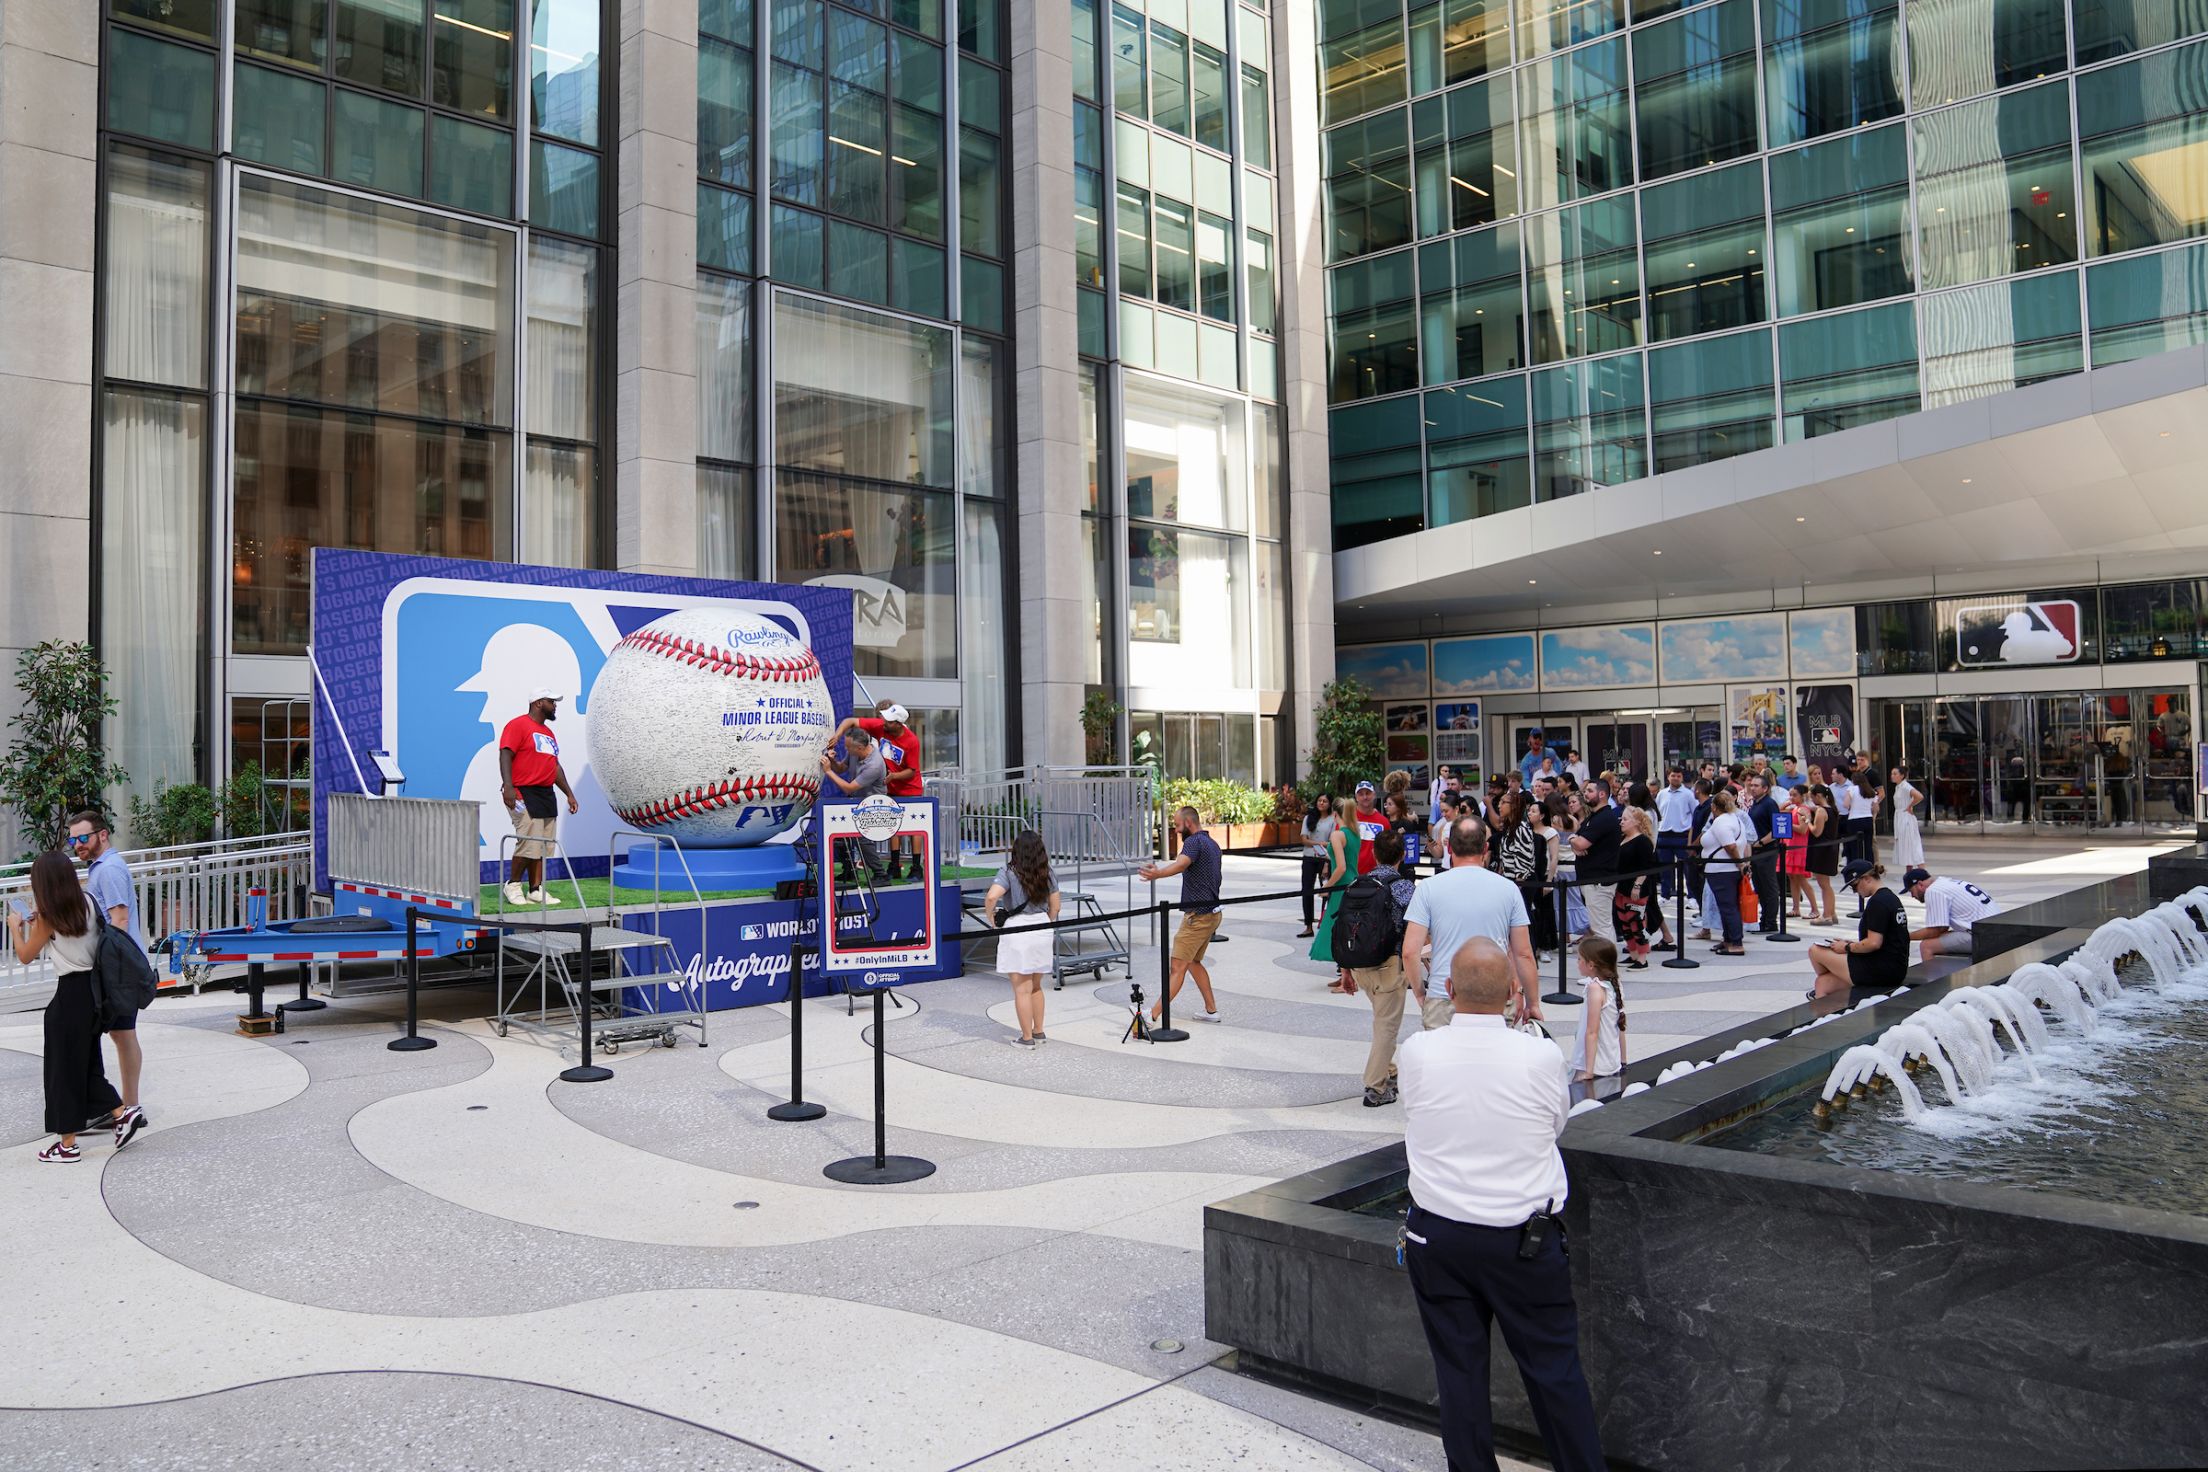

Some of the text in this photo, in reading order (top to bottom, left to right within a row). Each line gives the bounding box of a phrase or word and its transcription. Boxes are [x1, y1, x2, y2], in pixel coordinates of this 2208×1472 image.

[315, 552, 381, 575] SEBALL
[339, 566, 385, 589] MOST
[728, 626, 793, 648] Rawlings
[769, 697, 804, 709] OFFICIAL
[722, 711, 830, 728] MINOR LEAGUE BASEBALL
[1808, 714, 1842, 728] MLB
[1809, 744, 1842, 757] NYC
[1965, 884, 1993, 905] 9
[766, 917, 820, 938] WORLD'
[855, 954, 908, 965] #OnlyInMiLB
